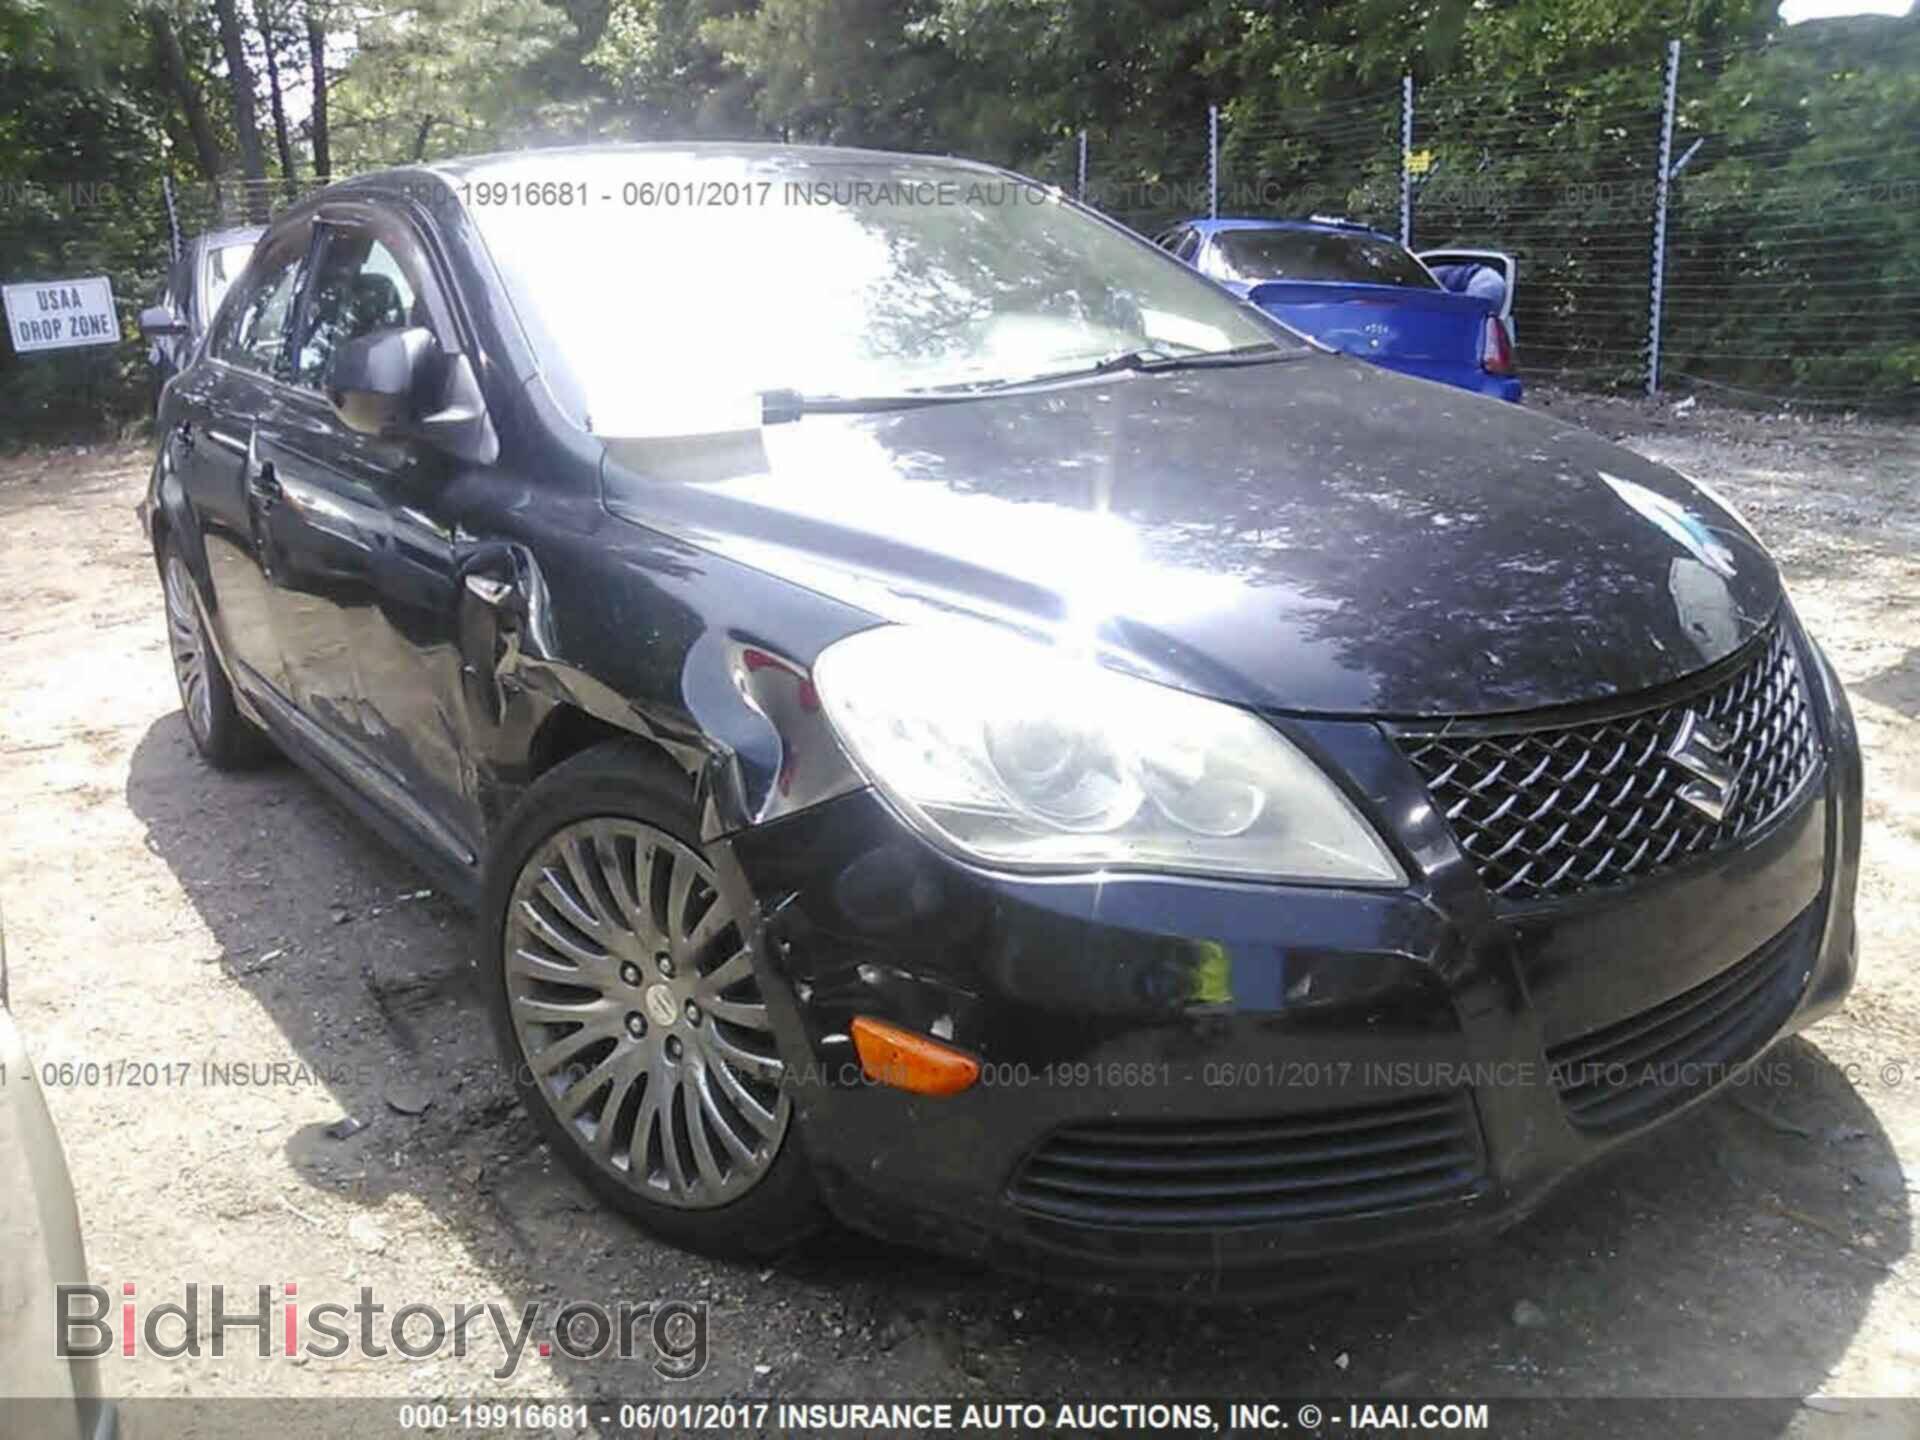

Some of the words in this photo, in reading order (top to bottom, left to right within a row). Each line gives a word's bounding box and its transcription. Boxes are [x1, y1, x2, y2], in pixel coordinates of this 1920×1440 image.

[36, 287, 82, 312] USAA
[19, 318, 62, 343] DROP
[69, 314, 111, 338] ZONE
